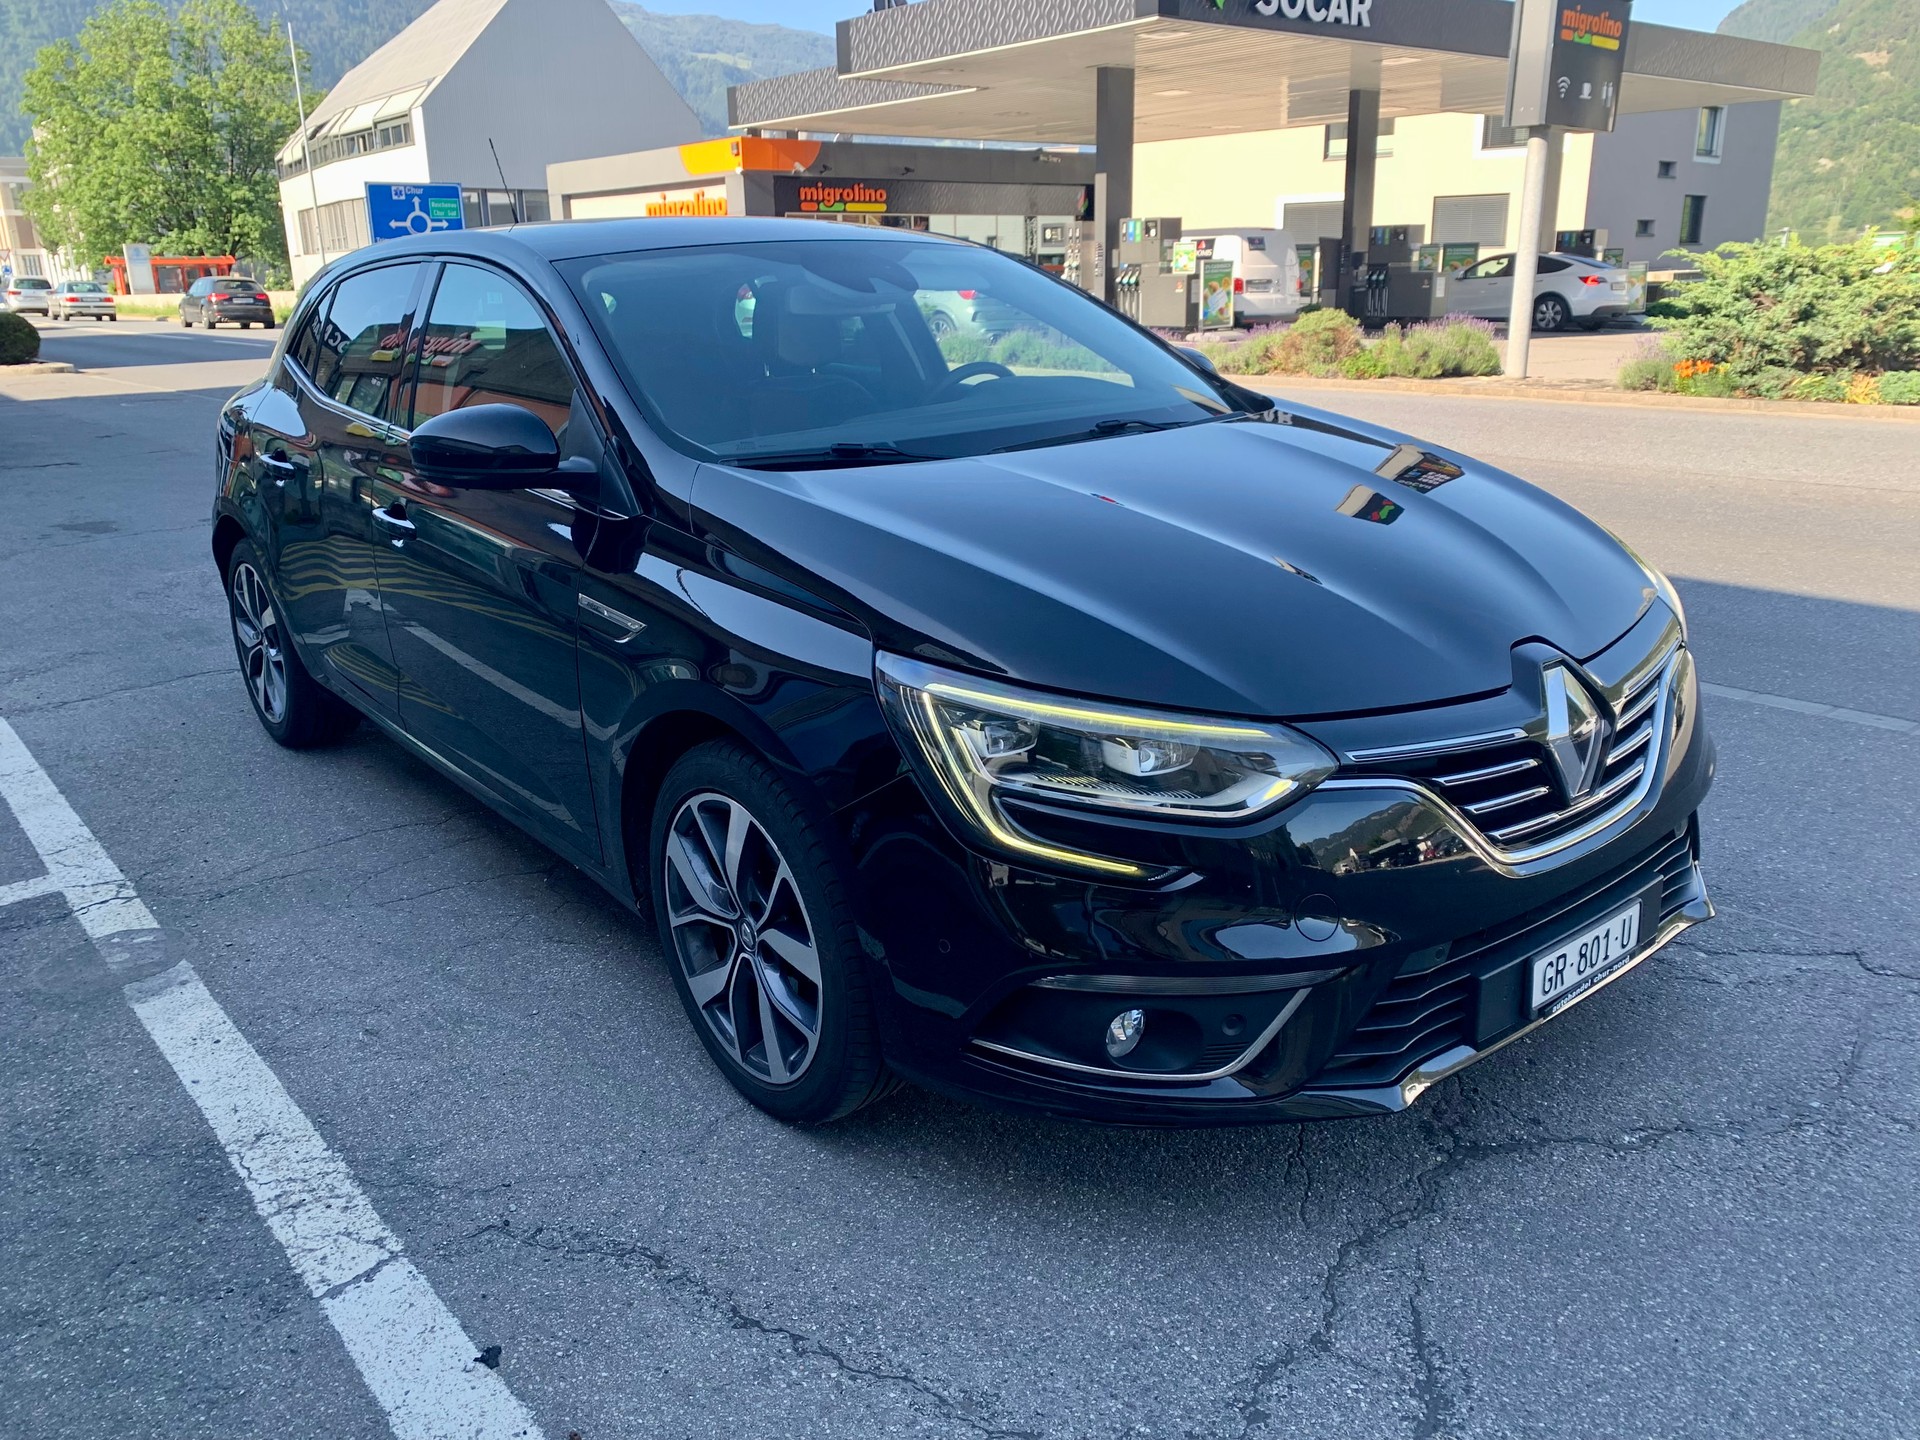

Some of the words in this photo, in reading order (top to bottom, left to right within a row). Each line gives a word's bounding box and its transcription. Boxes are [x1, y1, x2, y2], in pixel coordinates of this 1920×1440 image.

[1562, 5, 1622, 37] migrolino
[405, 186, 423, 194] Chur
[800, 182, 886, 206] migrolino
